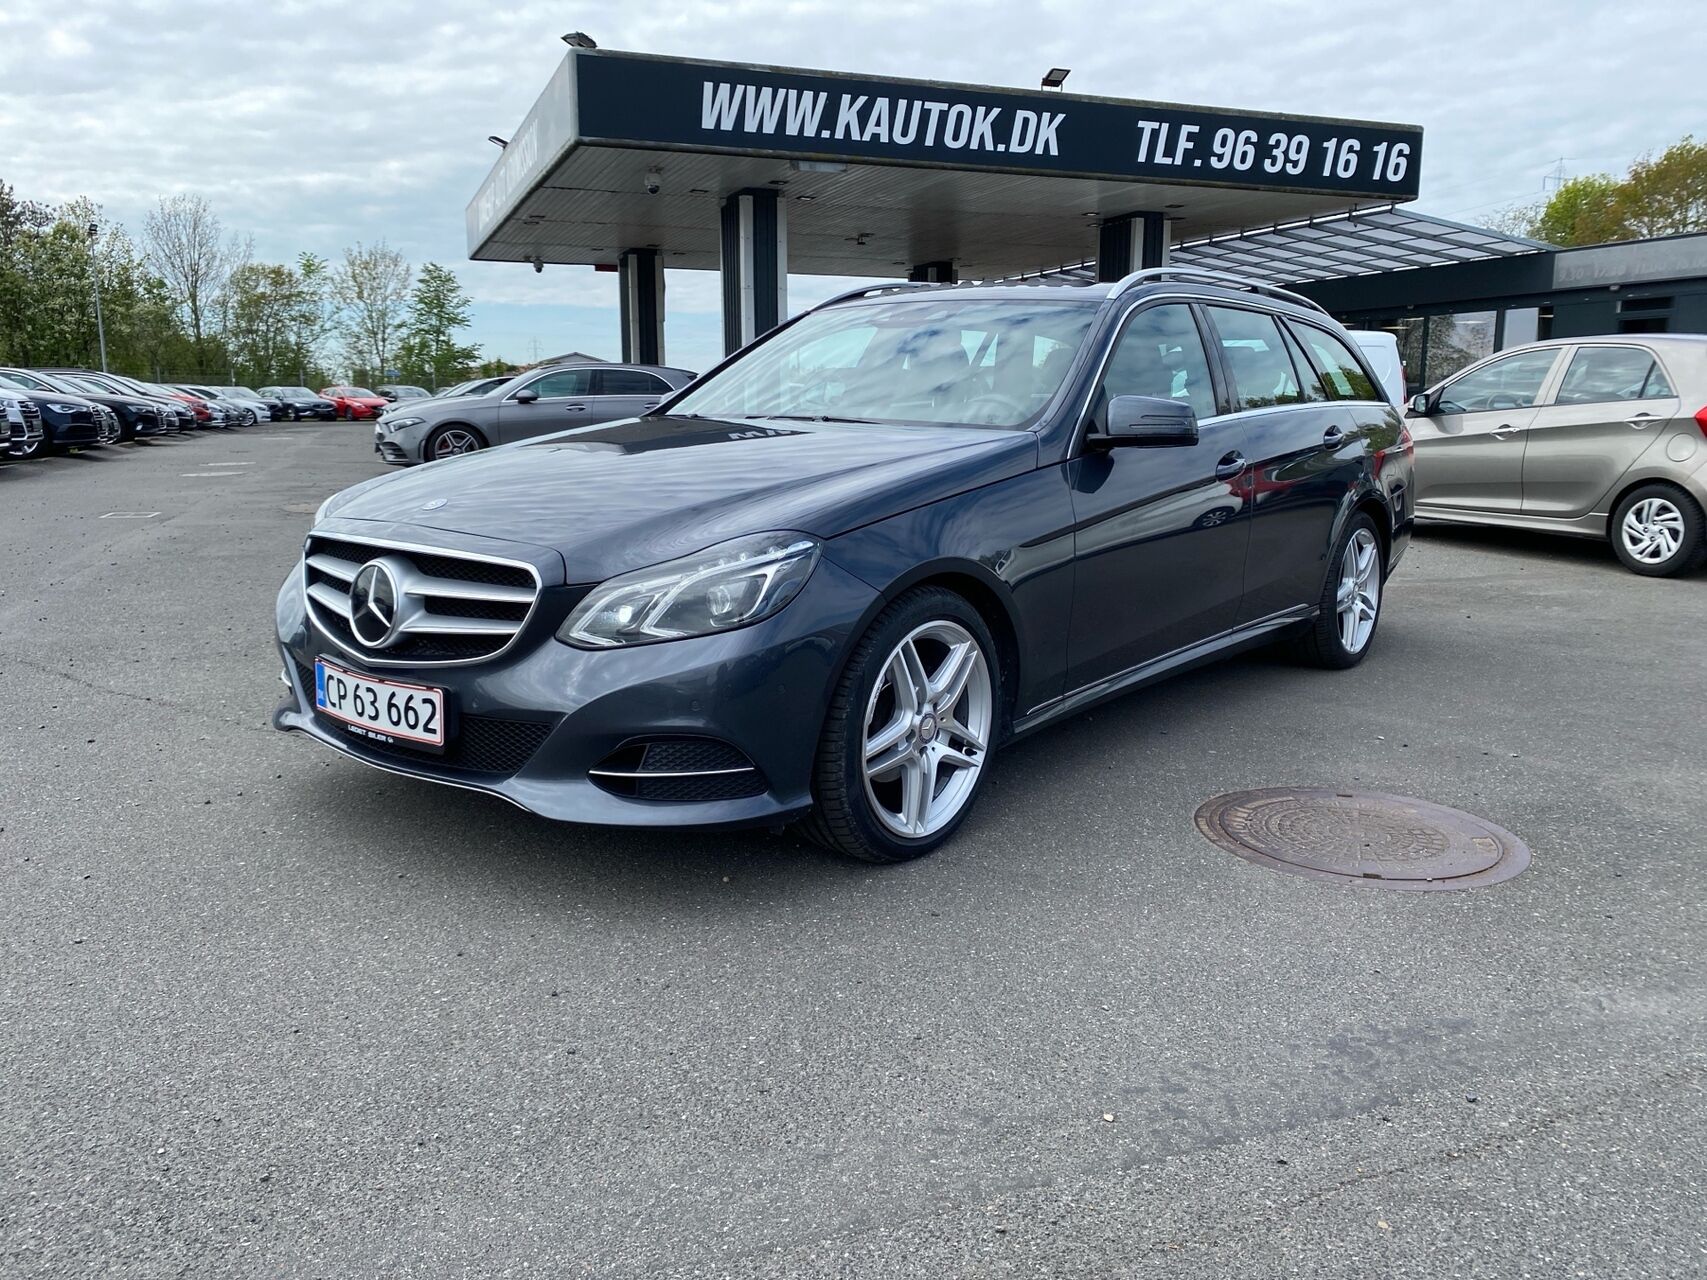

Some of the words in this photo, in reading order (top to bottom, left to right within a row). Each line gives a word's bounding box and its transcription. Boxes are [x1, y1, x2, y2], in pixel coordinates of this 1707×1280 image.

[702, 81, 1066, 156] WWW.KAUTOK.DK
[1137, 121, 1202, 166] TLF.
[1210, 128, 1258, 171] 96
[1264, 132, 1310, 175] 39
[1322, 138, 1361, 179] 16
[1372, 142, 1410, 182] 16
[327, 674, 348, 710] CP
[352, 683, 380, 722] 63
[387, 692, 437, 735] 662
